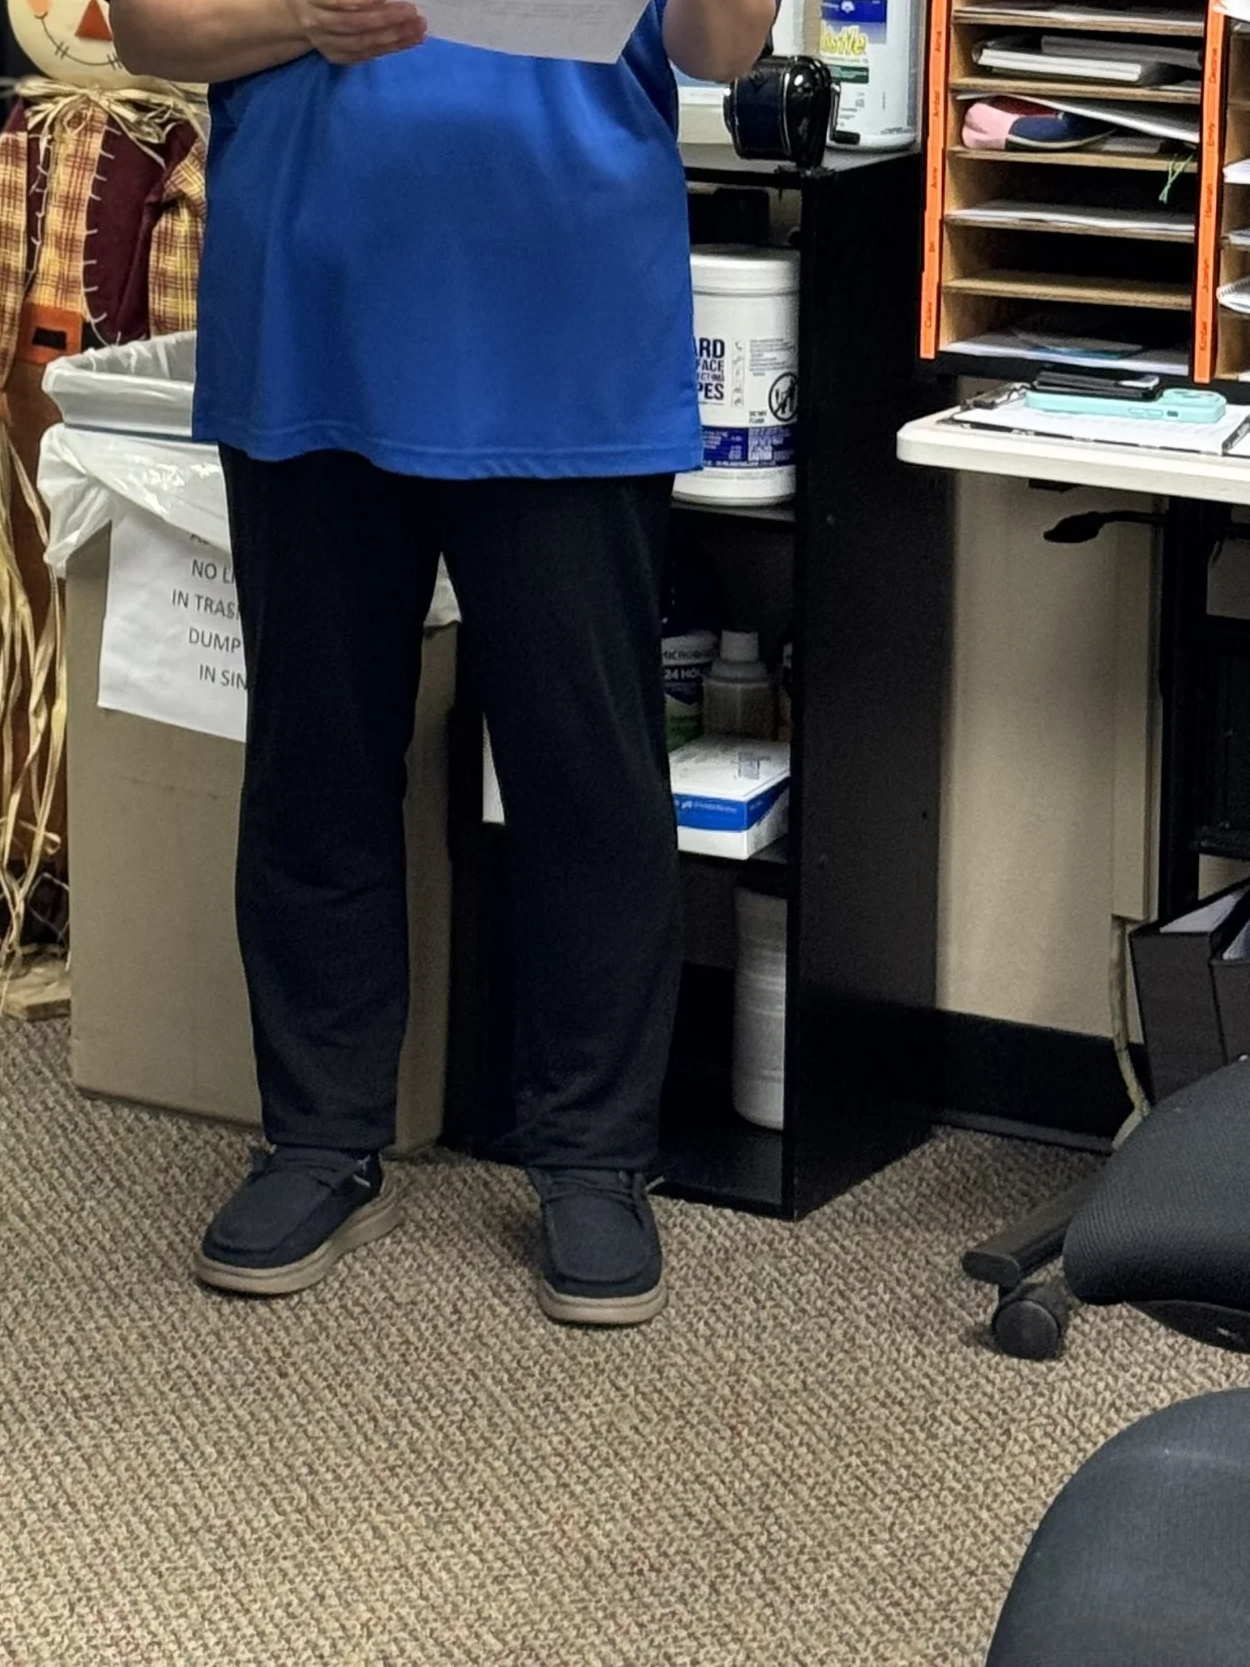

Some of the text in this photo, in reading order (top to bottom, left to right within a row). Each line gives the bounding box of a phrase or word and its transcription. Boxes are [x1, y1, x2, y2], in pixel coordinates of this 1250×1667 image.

[191, 558, 218, 580] NO
[172, 588, 189, 609] IN
[189, 626, 241, 653] DUMP
[199, 663, 216, 684] IN
